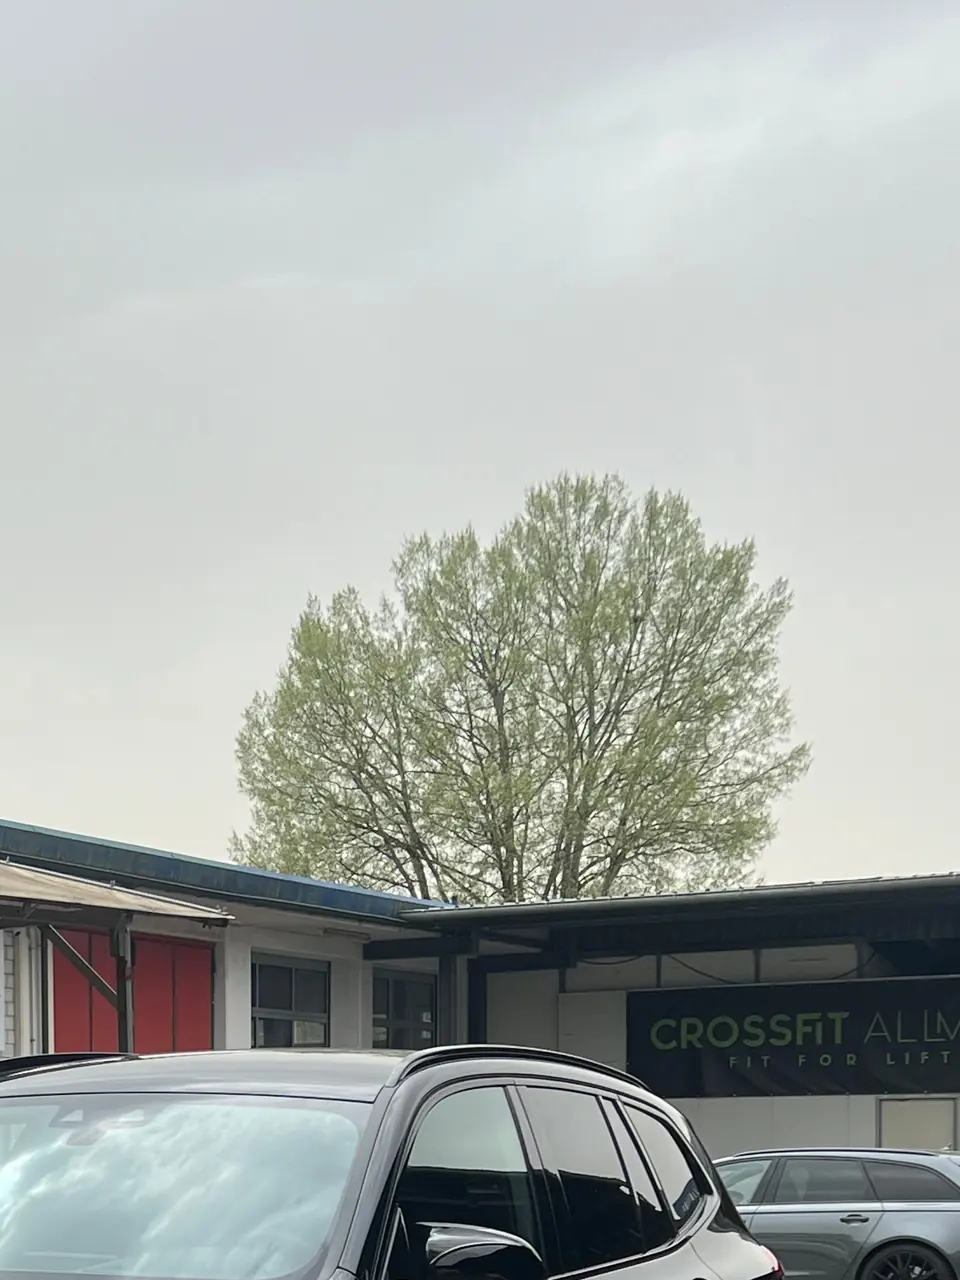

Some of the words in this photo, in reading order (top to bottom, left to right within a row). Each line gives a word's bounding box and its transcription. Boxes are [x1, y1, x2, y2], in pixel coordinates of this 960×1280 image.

[729, 1055, 771, 1069] FIT
[798, 1053, 857, 1067] FOR
[886, 1051, 951, 1066] LIFT
